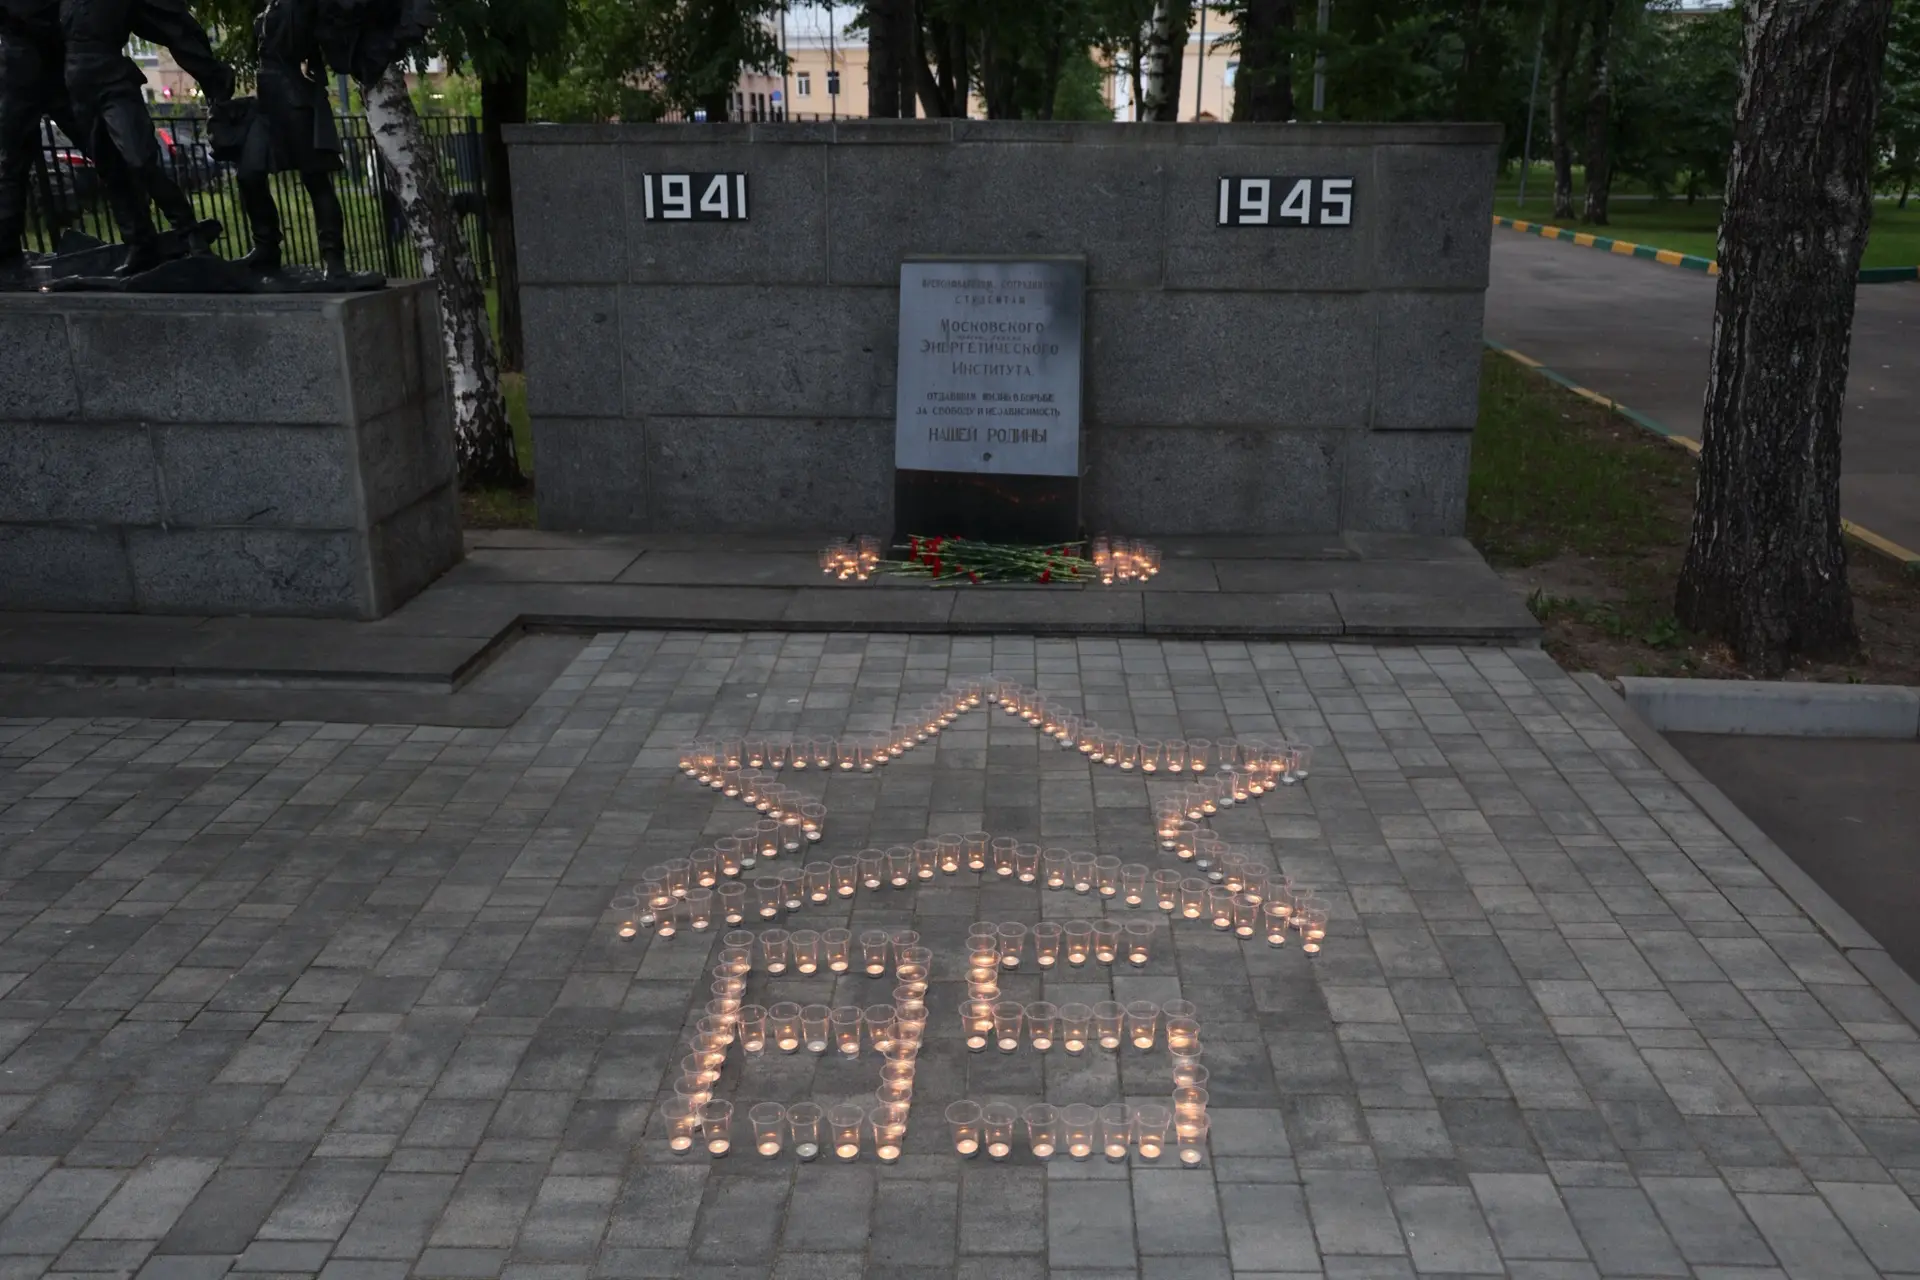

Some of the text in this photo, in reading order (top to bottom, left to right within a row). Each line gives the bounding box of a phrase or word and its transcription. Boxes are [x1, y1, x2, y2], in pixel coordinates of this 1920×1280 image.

[643, 174, 746, 219] 1941
[1219, 178, 1353, 225] 1945
[940, 318, 1045, 334] МОСКОВСКОГО
[920, 339, 1059, 356] ЭНЕРГЕТИЧЕСКОГО
[927, 391, 976, 401] ОТДАВШИМ
[1020, 393, 1054, 403] БОРЬБЕ
[916, 406, 927, 415] ЗА
[932, 407, 975, 416] СВОБОДУ
[986, 407, 1060, 417] НЕЗАВИСИМОСТЬ
[929, 426, 1048, 444] НАШЕЙ РОДИНЫ
